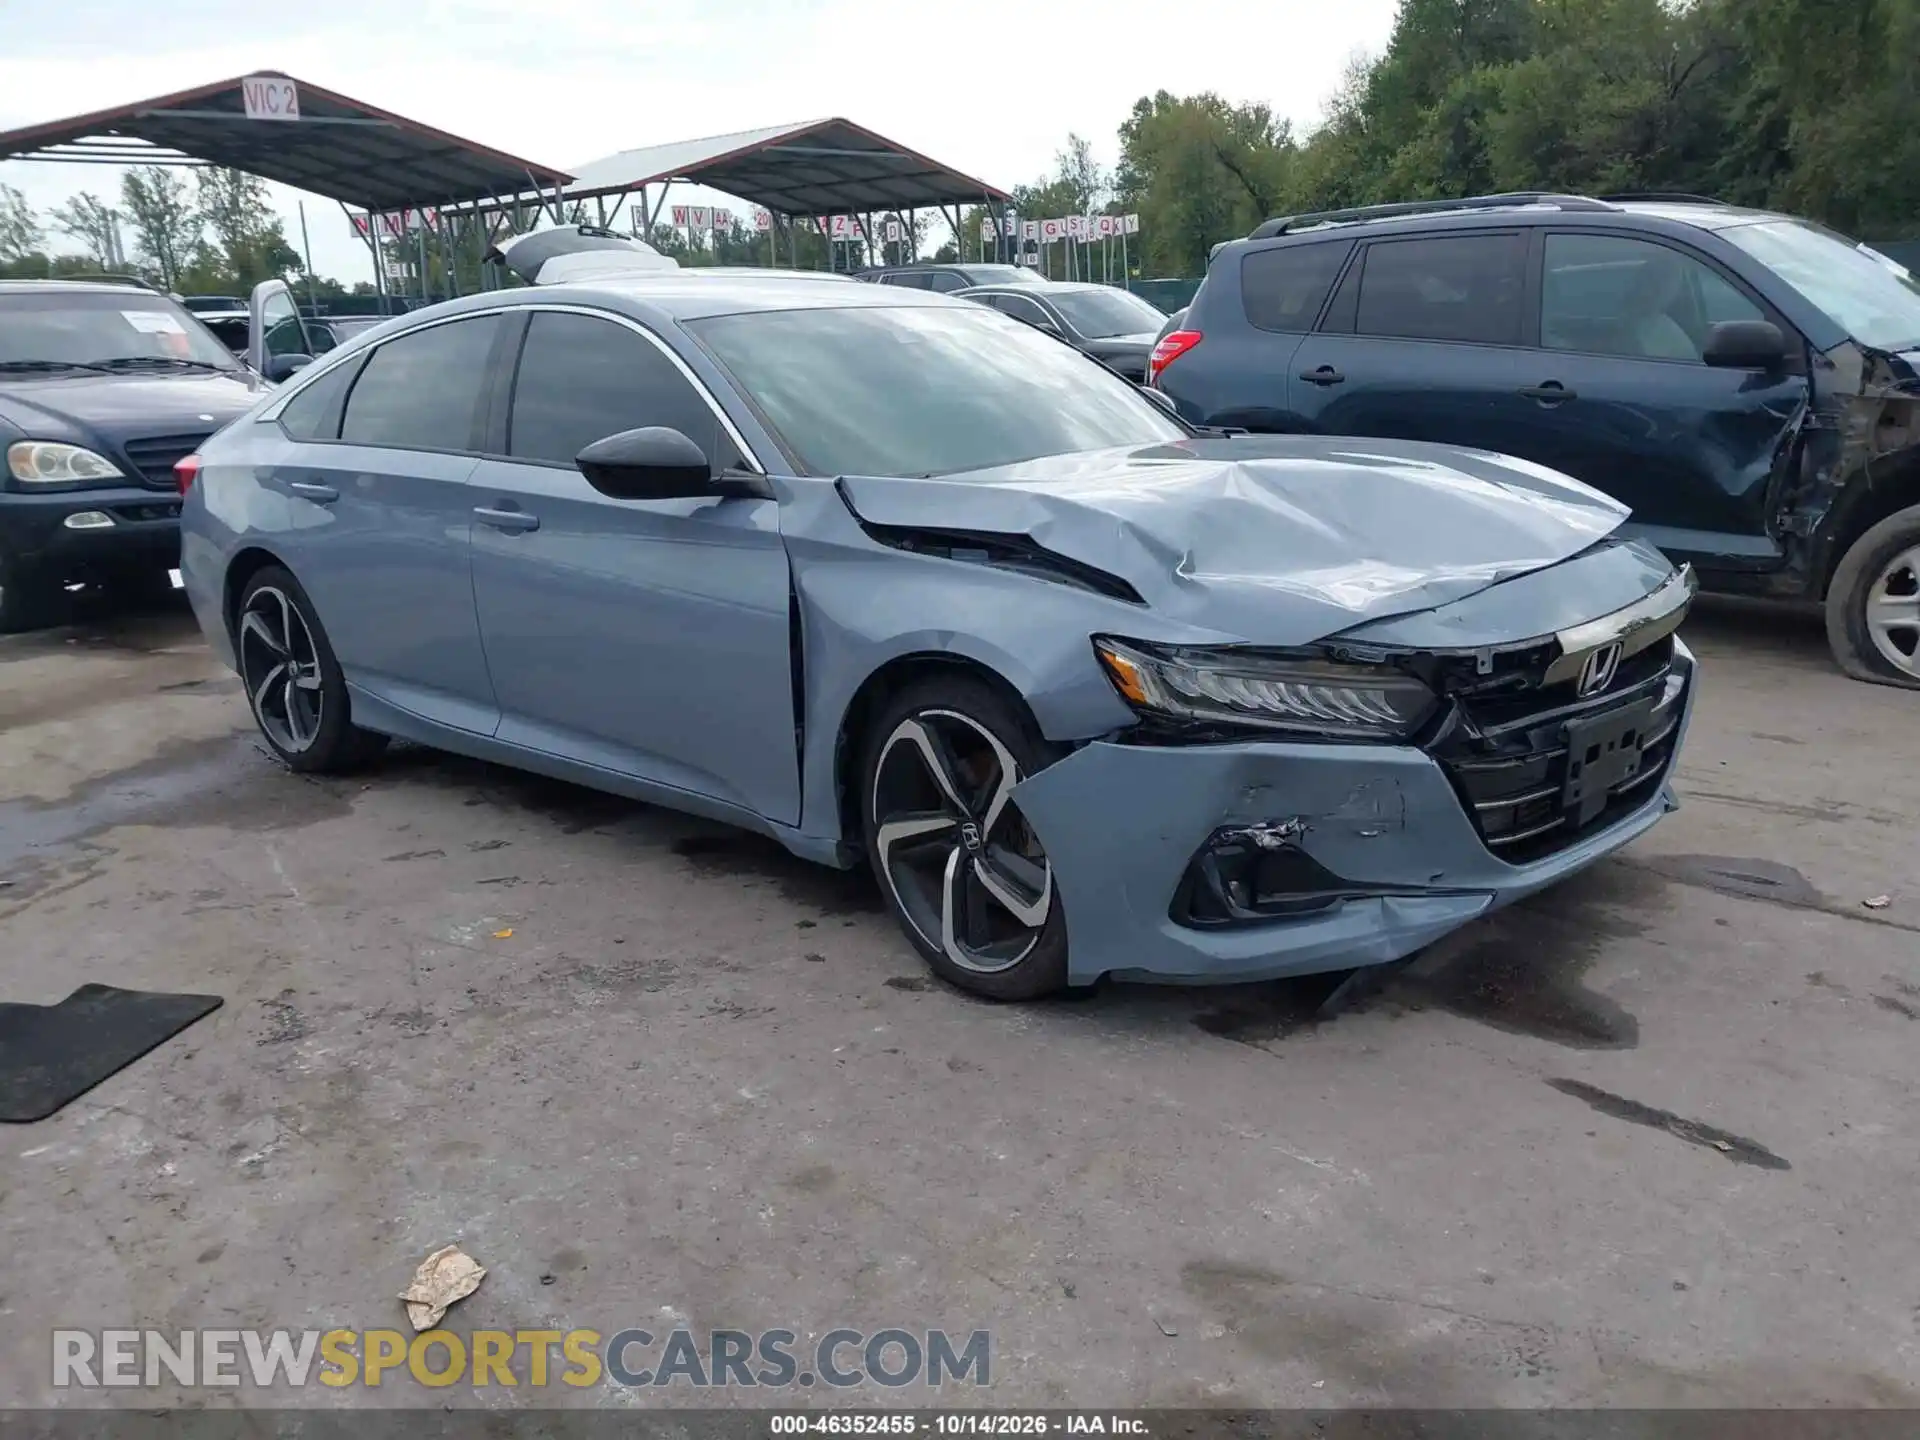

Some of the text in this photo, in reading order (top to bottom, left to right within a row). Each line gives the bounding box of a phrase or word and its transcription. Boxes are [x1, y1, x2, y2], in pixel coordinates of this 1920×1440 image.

[244, 83, 297, 114] VIC 2
[673, 209, 686, 225] W
[694, 210, 704, 225] V
[715, 211, 729, 225] AA
[756, 211, 769, 226] 20
[1045, 222, 1056, 235] G
